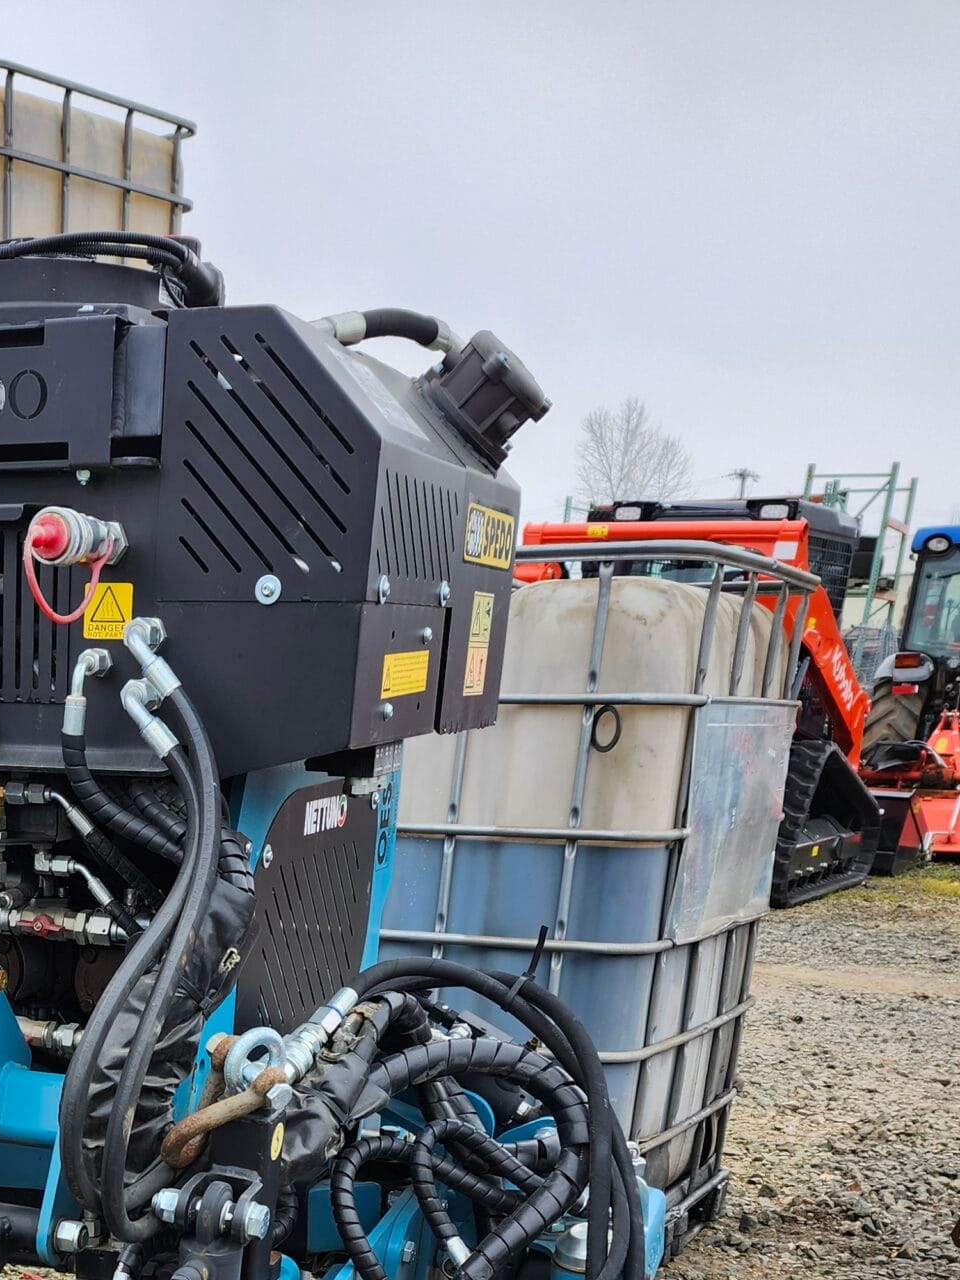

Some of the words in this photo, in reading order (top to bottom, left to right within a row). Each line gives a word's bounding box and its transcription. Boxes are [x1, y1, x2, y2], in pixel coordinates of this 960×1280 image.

[483, 515, 513, 562] SPEDO
[832, 643, 855, 712] Kubota
[303, 794, 347, 836] NETTUNO
